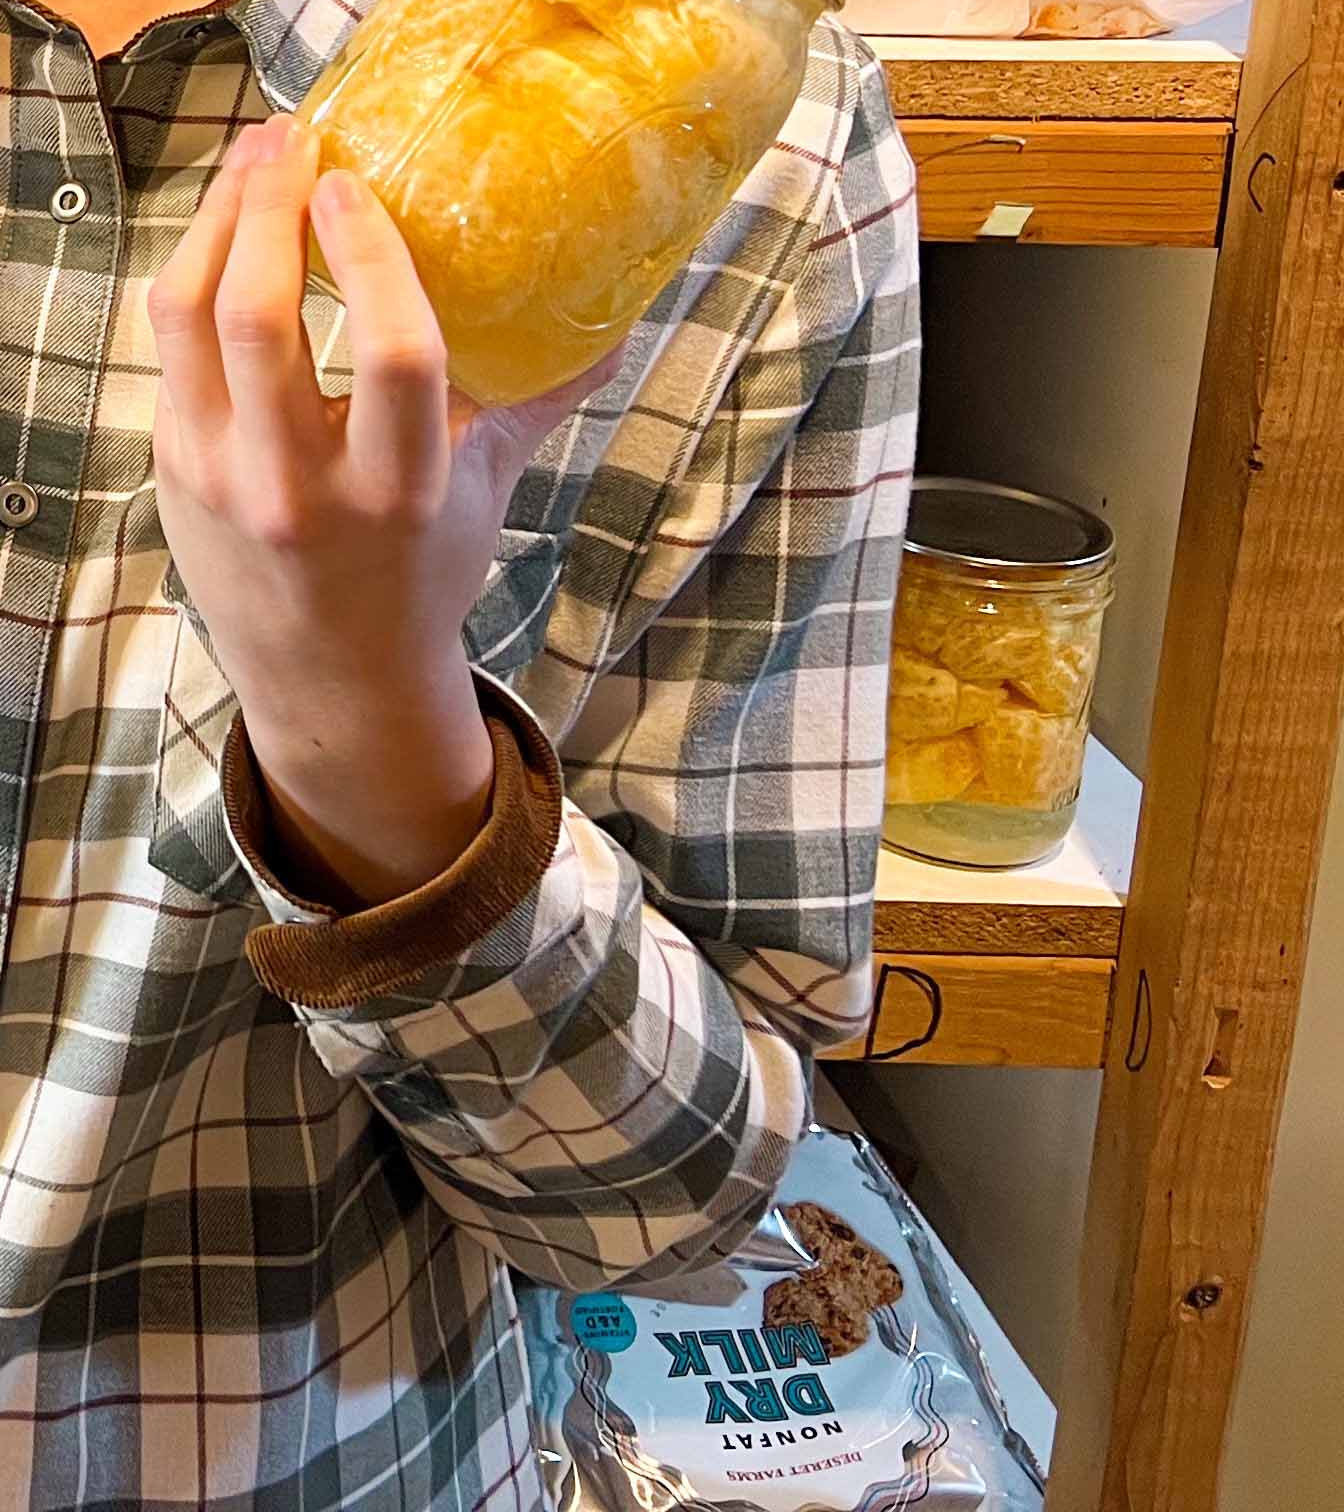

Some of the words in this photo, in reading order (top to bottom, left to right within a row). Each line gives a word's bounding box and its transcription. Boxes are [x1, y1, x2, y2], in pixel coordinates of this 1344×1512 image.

[857, 963, 943, 1061] D
[653, 1320, 832, 1378] MILK
[704, 1373, 835, 1424] DRY
[722, 1419, 844, 1451] NONFAT
[725, 1461, 787, 1483] FARMS
[789, 1449, 863, 1476] DESERET
